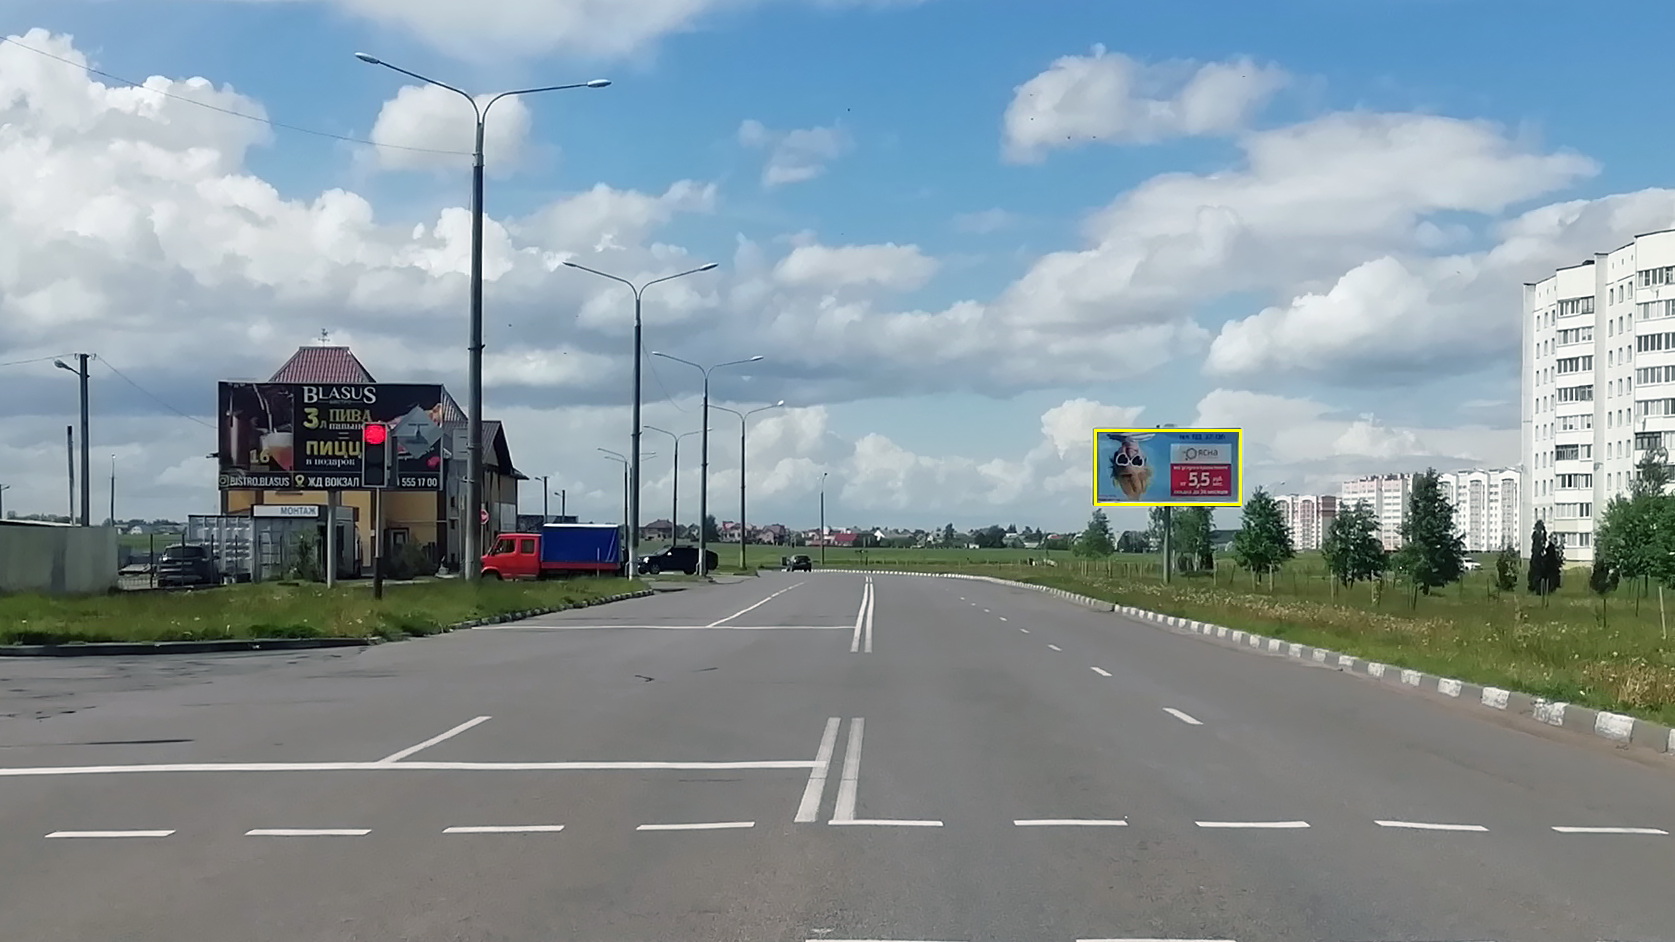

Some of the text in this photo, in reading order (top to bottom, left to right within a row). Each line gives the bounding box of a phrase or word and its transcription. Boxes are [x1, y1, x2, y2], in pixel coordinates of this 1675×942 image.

[303, 386, 377, 404] BLASUS
[329, 408, 372, 422] ПИВА
[306, 440, 362, 459] ПИЦЦ
[249, 449, 270, 464] 16
[314, 459, 356, 468] подарок
[229, 476, 291, 488] BISTRO.BLASUS
[307, 476, 360, 488] ЖД ВОКЗАЛ
[401, 477, 438, 487] 555 17 00
[1188, 472, 1211, 489] 5,5
[280, 506, 317, 515] МОНТАЖ
